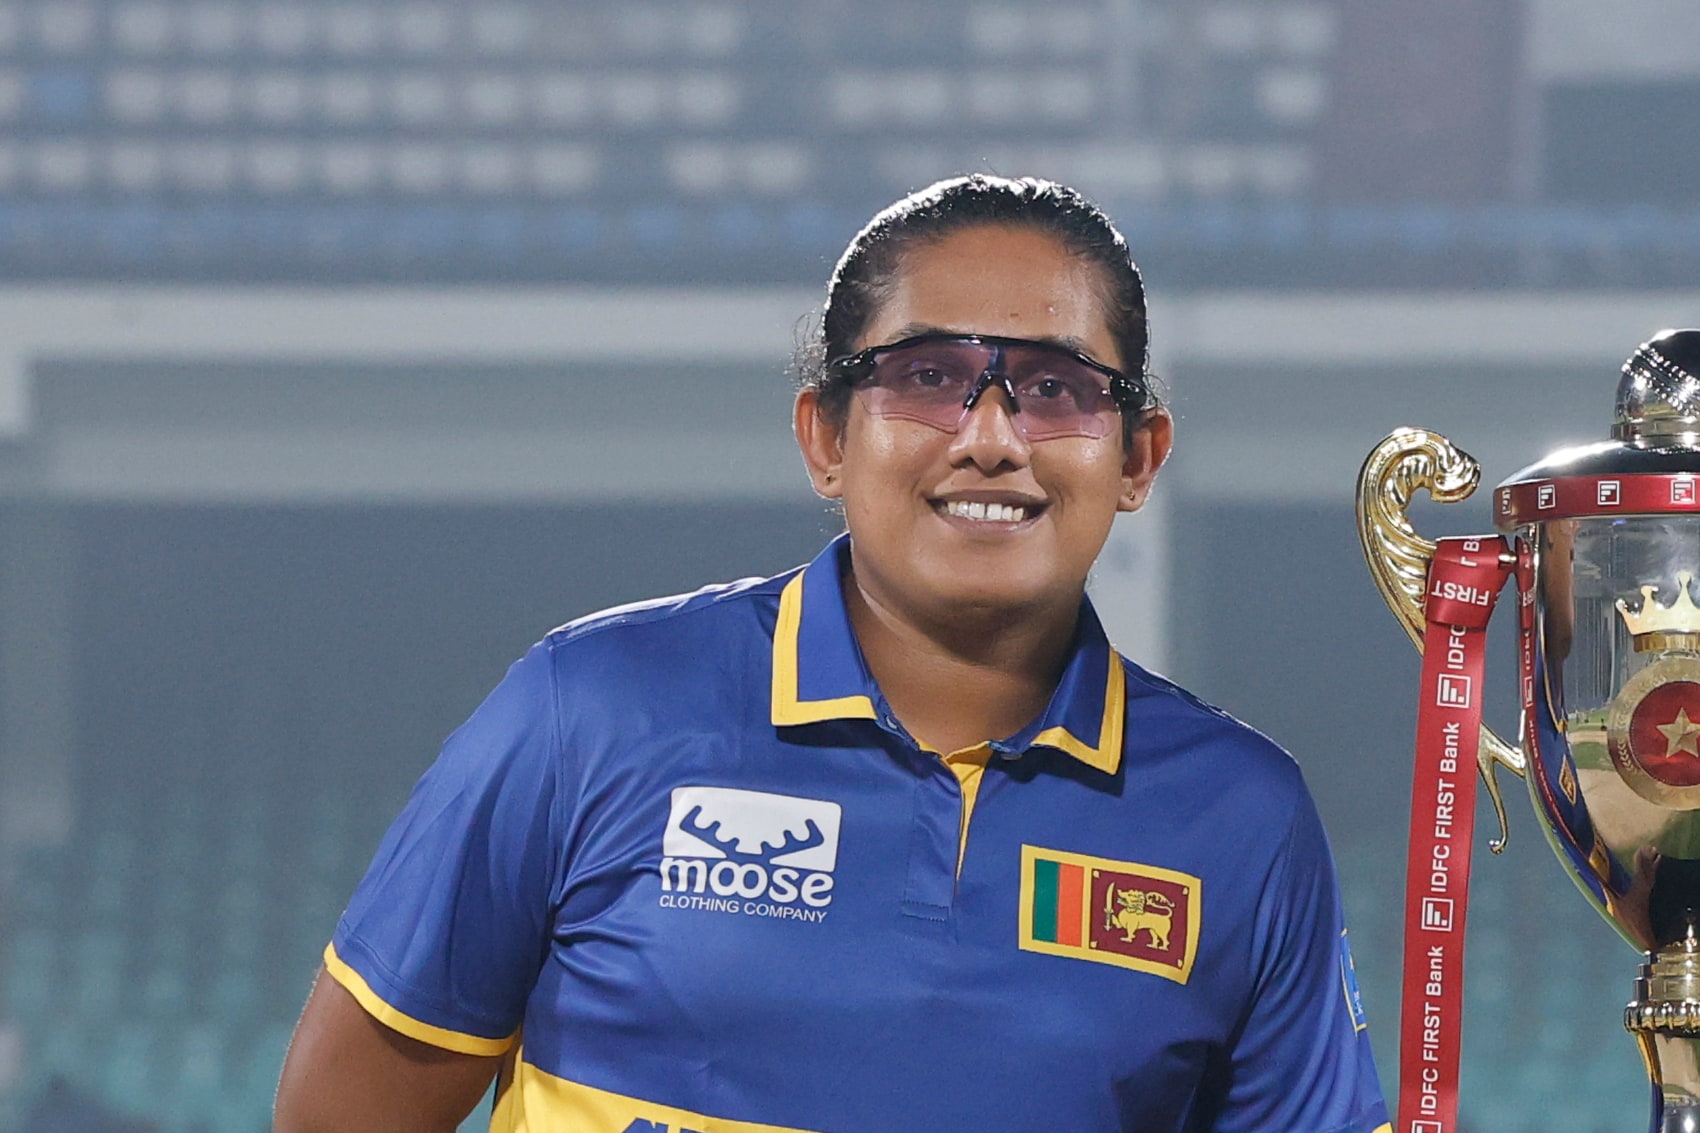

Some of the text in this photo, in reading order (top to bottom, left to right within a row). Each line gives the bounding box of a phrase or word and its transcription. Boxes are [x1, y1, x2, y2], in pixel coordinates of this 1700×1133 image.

[1431, 580, 1490, 607] FIRST
[1439, 721, 1461, 773] Bank
[1434, 778, 1456, 838] FIRST
[659, 857, 834, 907] moose
[1430, 844, 1451, 893] IDFC
[659, 894, 828, 924] CLOTHING COMPANY
[1425, 945, 1445, 997] Bank
[1422, 1001, 1441, 1062] FIRST
[1420, 1067, 1440, 1116] IDFC
